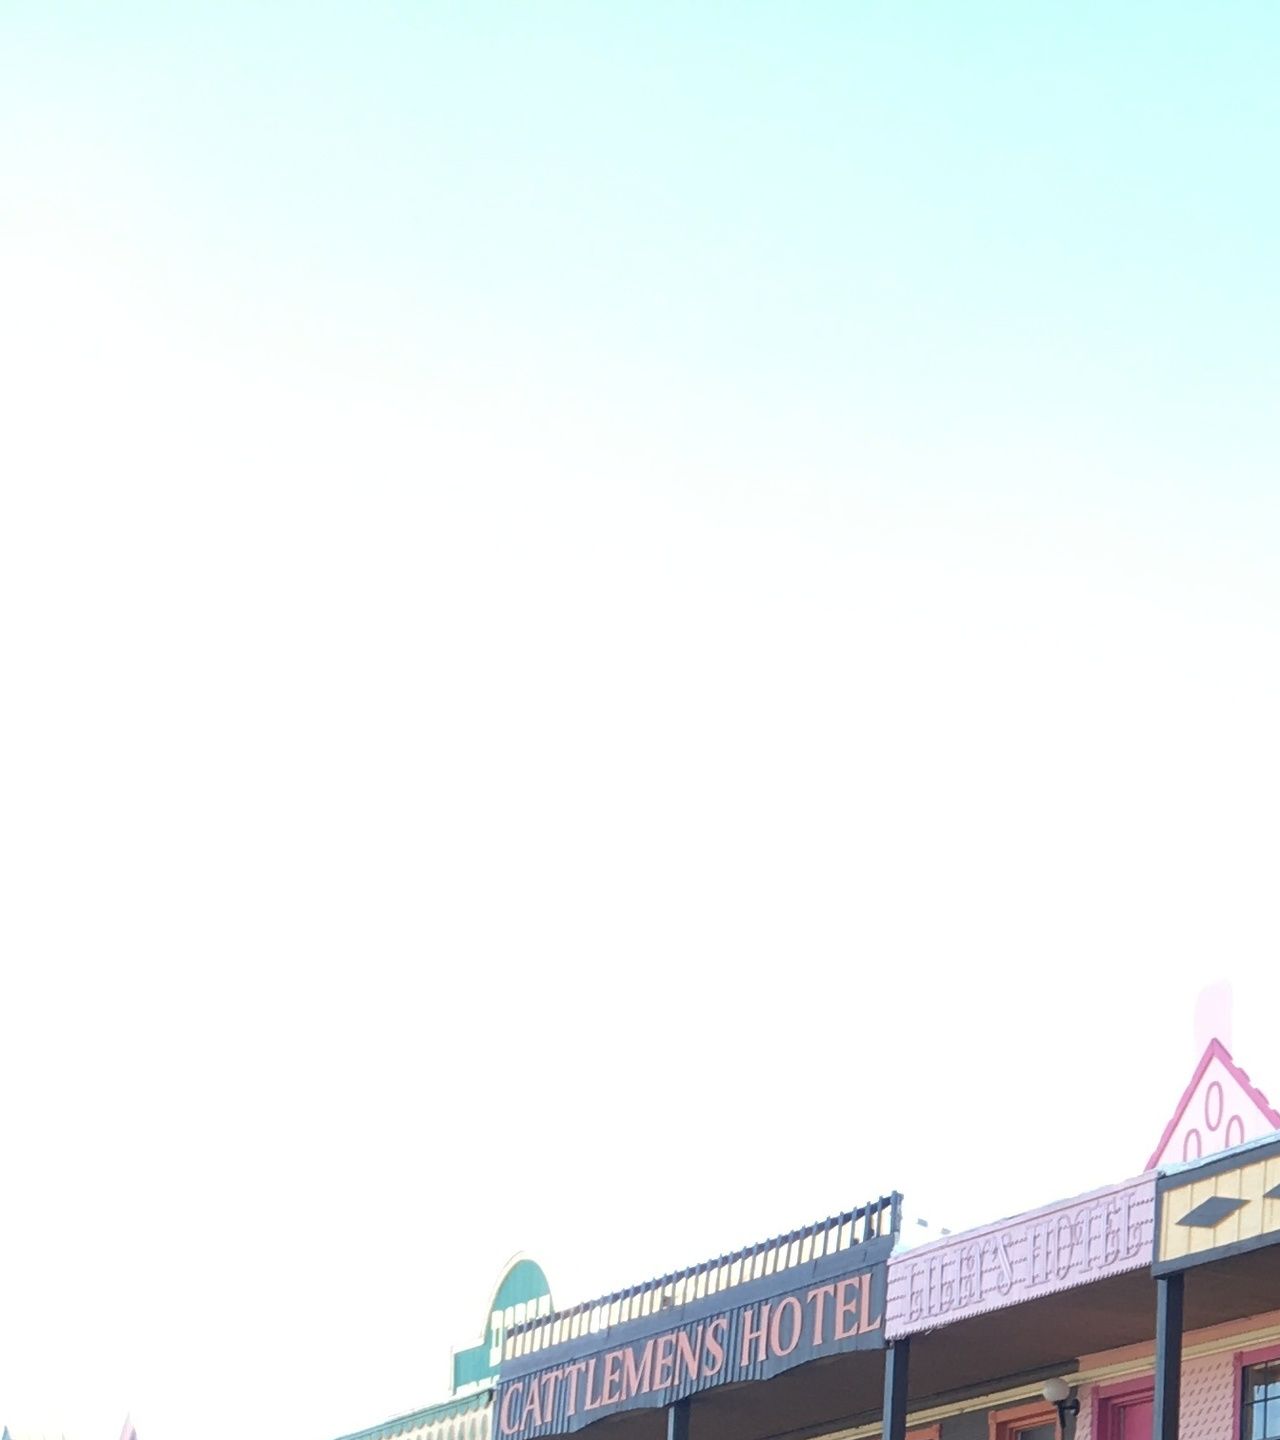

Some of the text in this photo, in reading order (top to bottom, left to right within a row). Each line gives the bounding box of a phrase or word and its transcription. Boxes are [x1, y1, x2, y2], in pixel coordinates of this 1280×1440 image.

[1024, 1191, 1143, 1289] HOTEL
[500, 1272, 882, 1435] CATTLEMENS HOTEL
